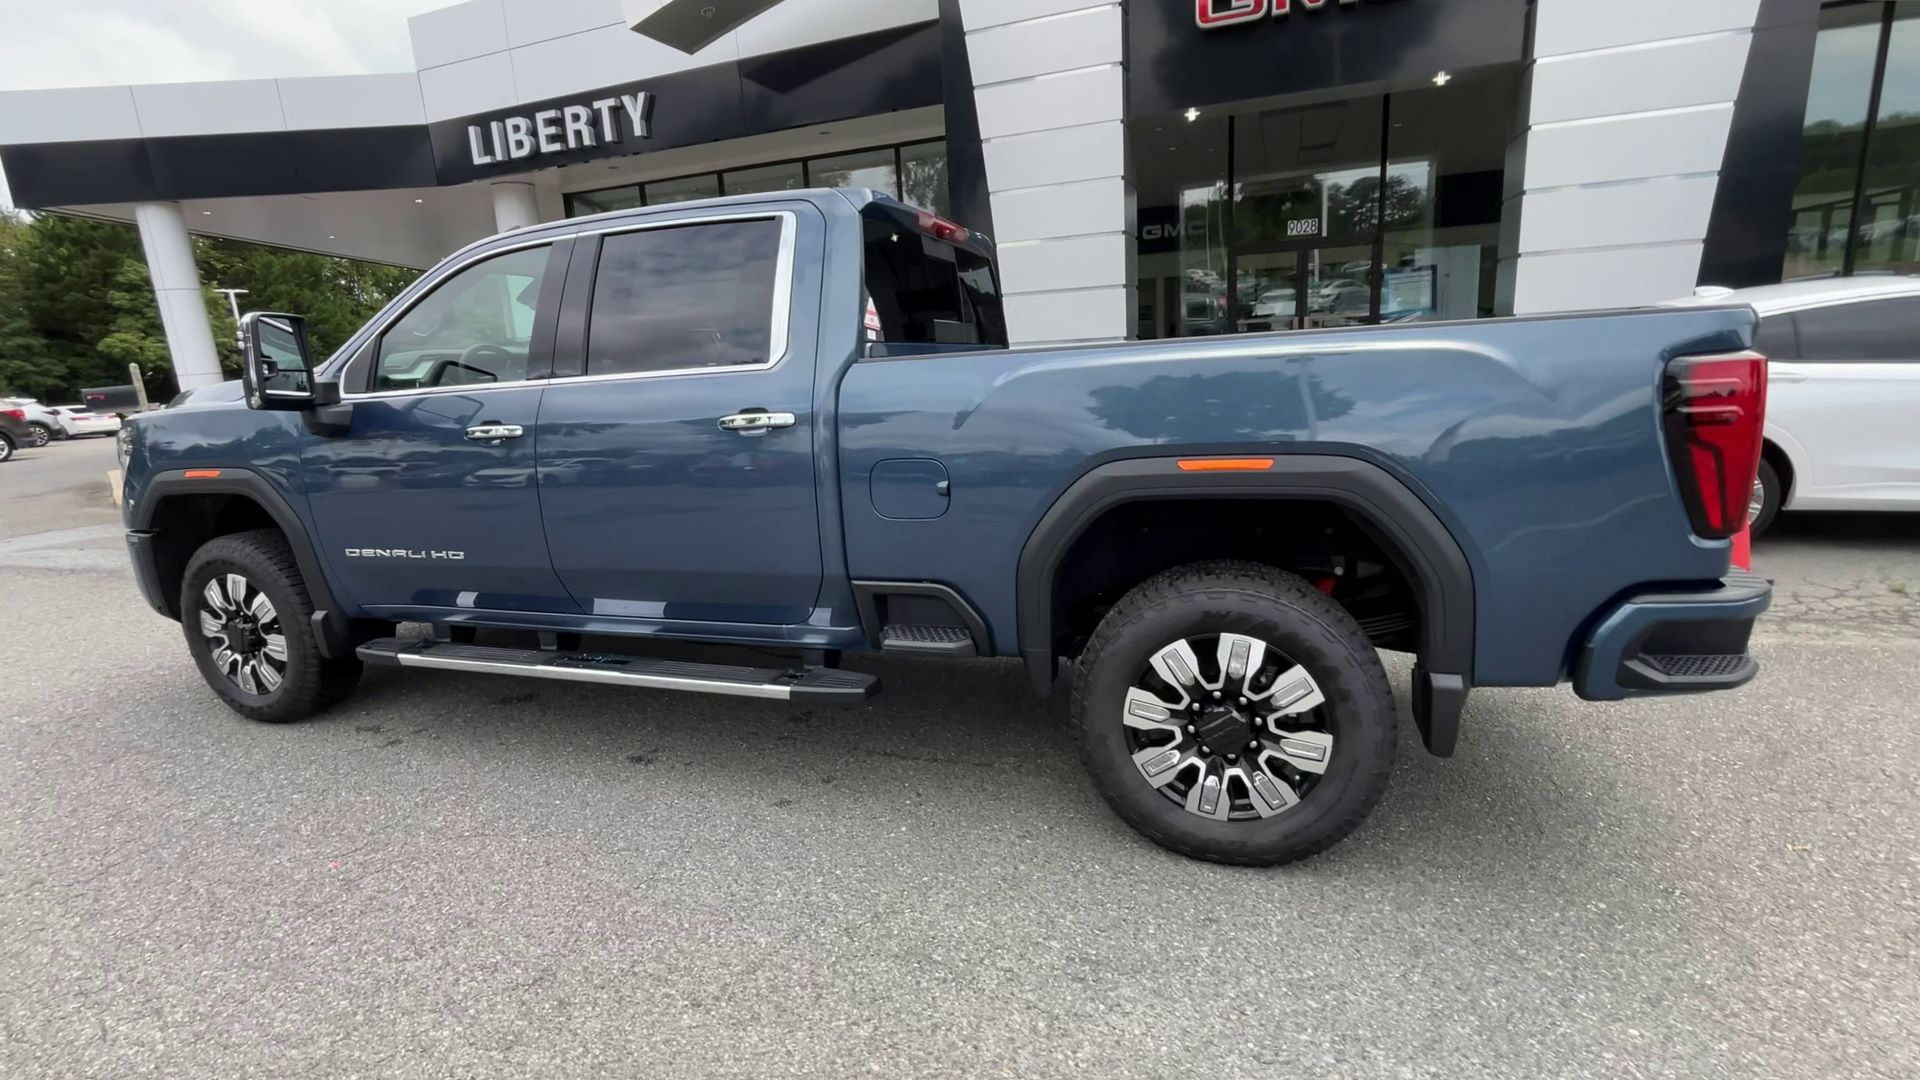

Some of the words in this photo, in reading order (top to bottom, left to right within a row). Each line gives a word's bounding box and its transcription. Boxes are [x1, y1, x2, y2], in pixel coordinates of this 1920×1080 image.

[468, 91, 652, 164] LIBERTY
[1142, 221, 1204, 240] GMC
[1287, 219, 1318, 234] 9028
[344, 548, 425, 558] DENALI
[430, 550, 465, 559] HD
